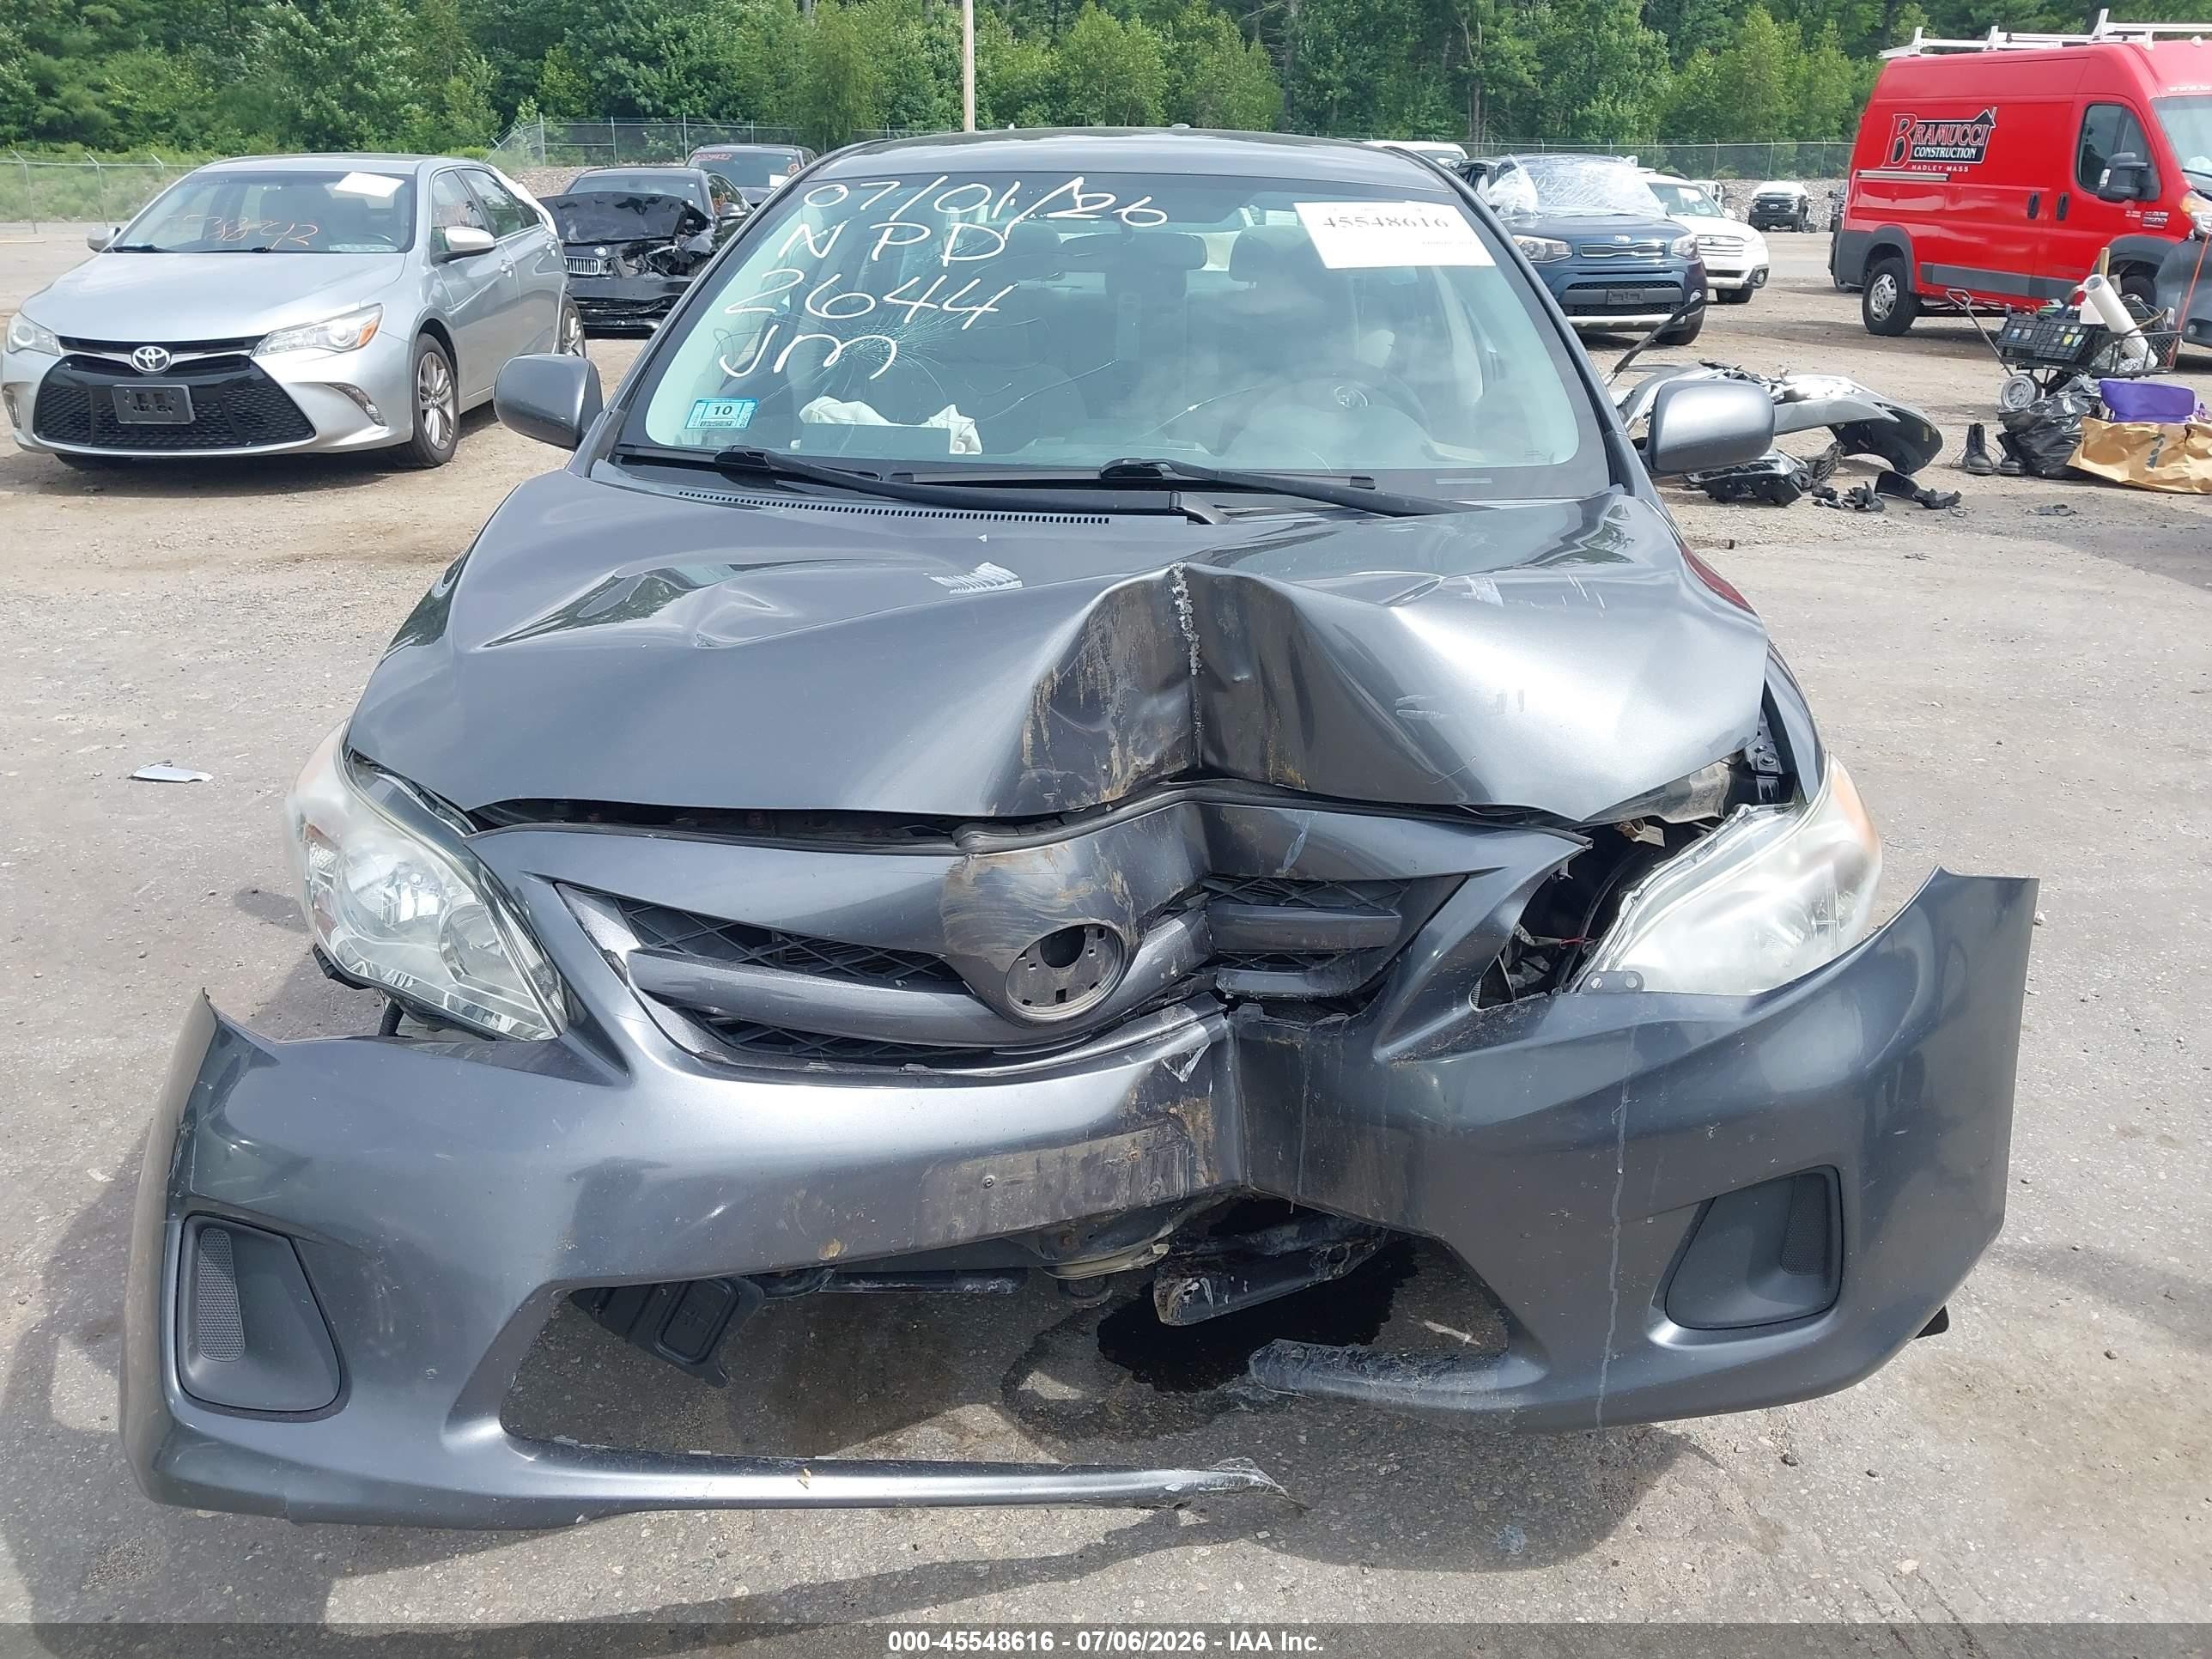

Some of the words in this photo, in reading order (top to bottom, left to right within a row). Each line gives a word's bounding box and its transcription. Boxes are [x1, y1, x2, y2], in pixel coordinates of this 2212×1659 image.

[1881, 113, 1990, 169] BRAMUCCI
[1914, 146, 1977, 159] CONSTRUCTION
[1323, 216, 1450, 228] 45548616
[725, 268, 1018, 330] 2644
[714, 405, 732, 416] 10
